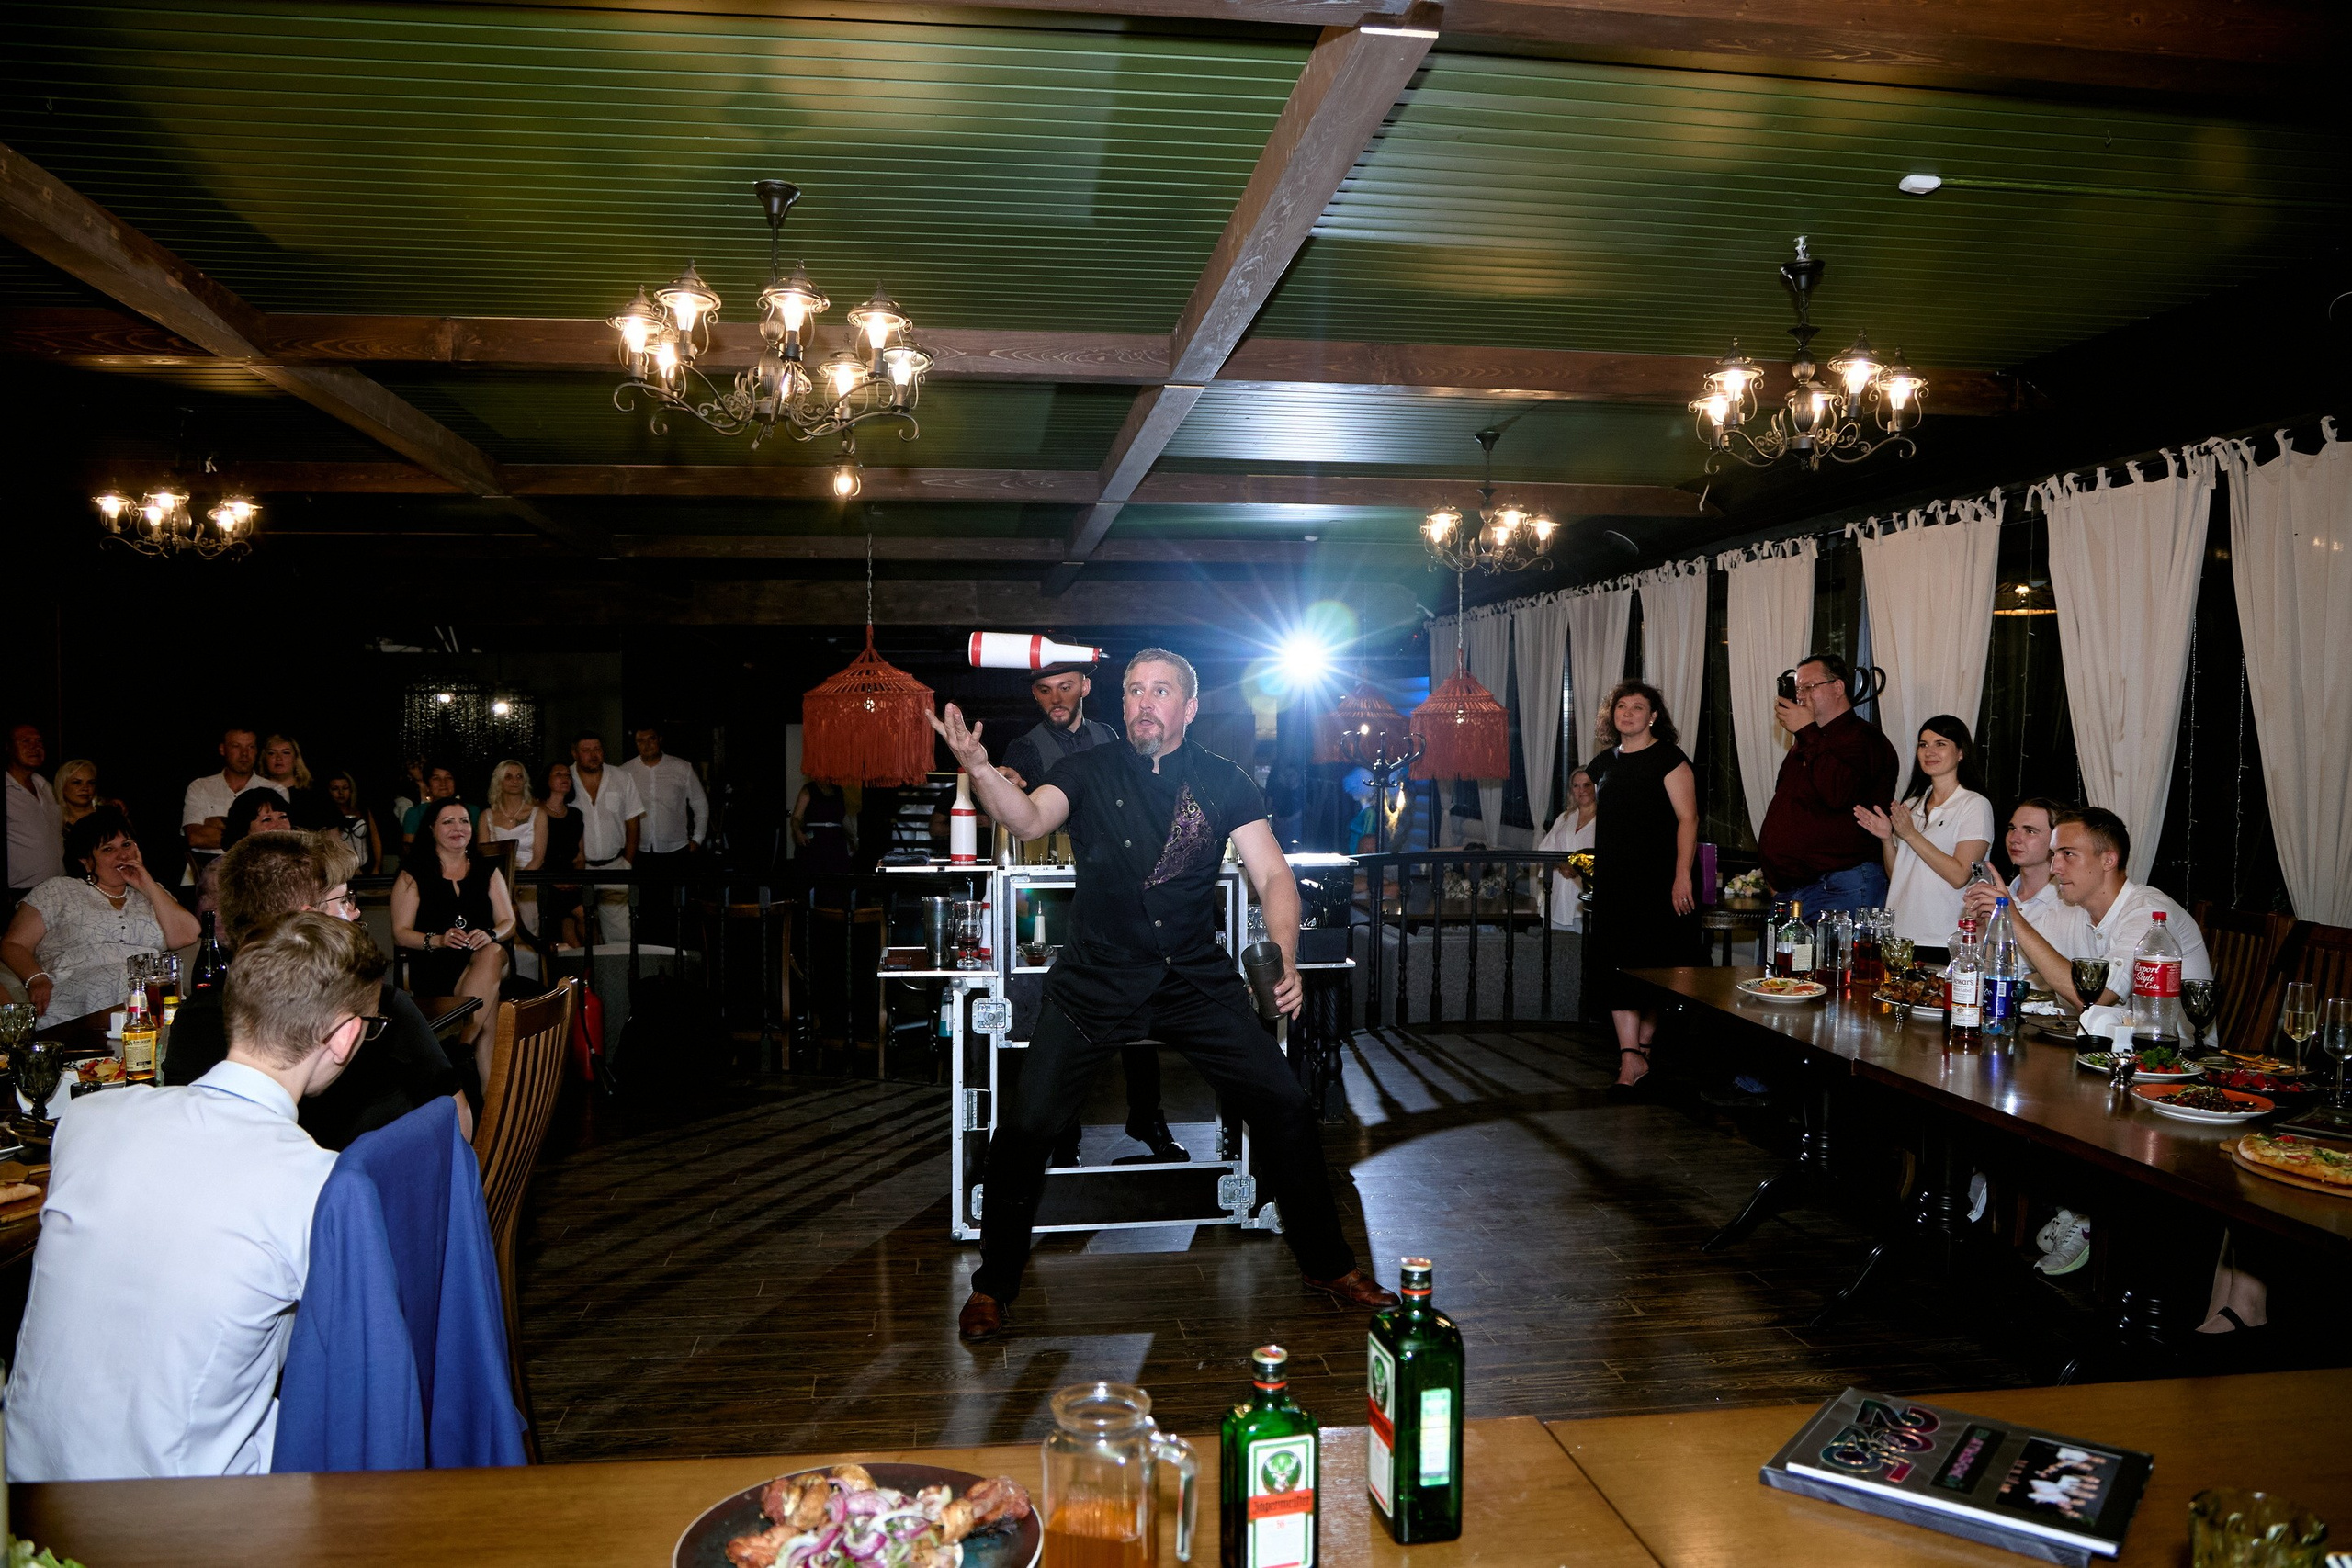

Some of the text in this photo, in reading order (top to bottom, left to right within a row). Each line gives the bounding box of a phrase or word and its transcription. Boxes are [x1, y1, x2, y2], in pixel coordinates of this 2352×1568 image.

[2135, 962, 2162, 976] Export
[2136, 971, 2155, 985] Style
[2144, 982, 2161, 990] Cola
